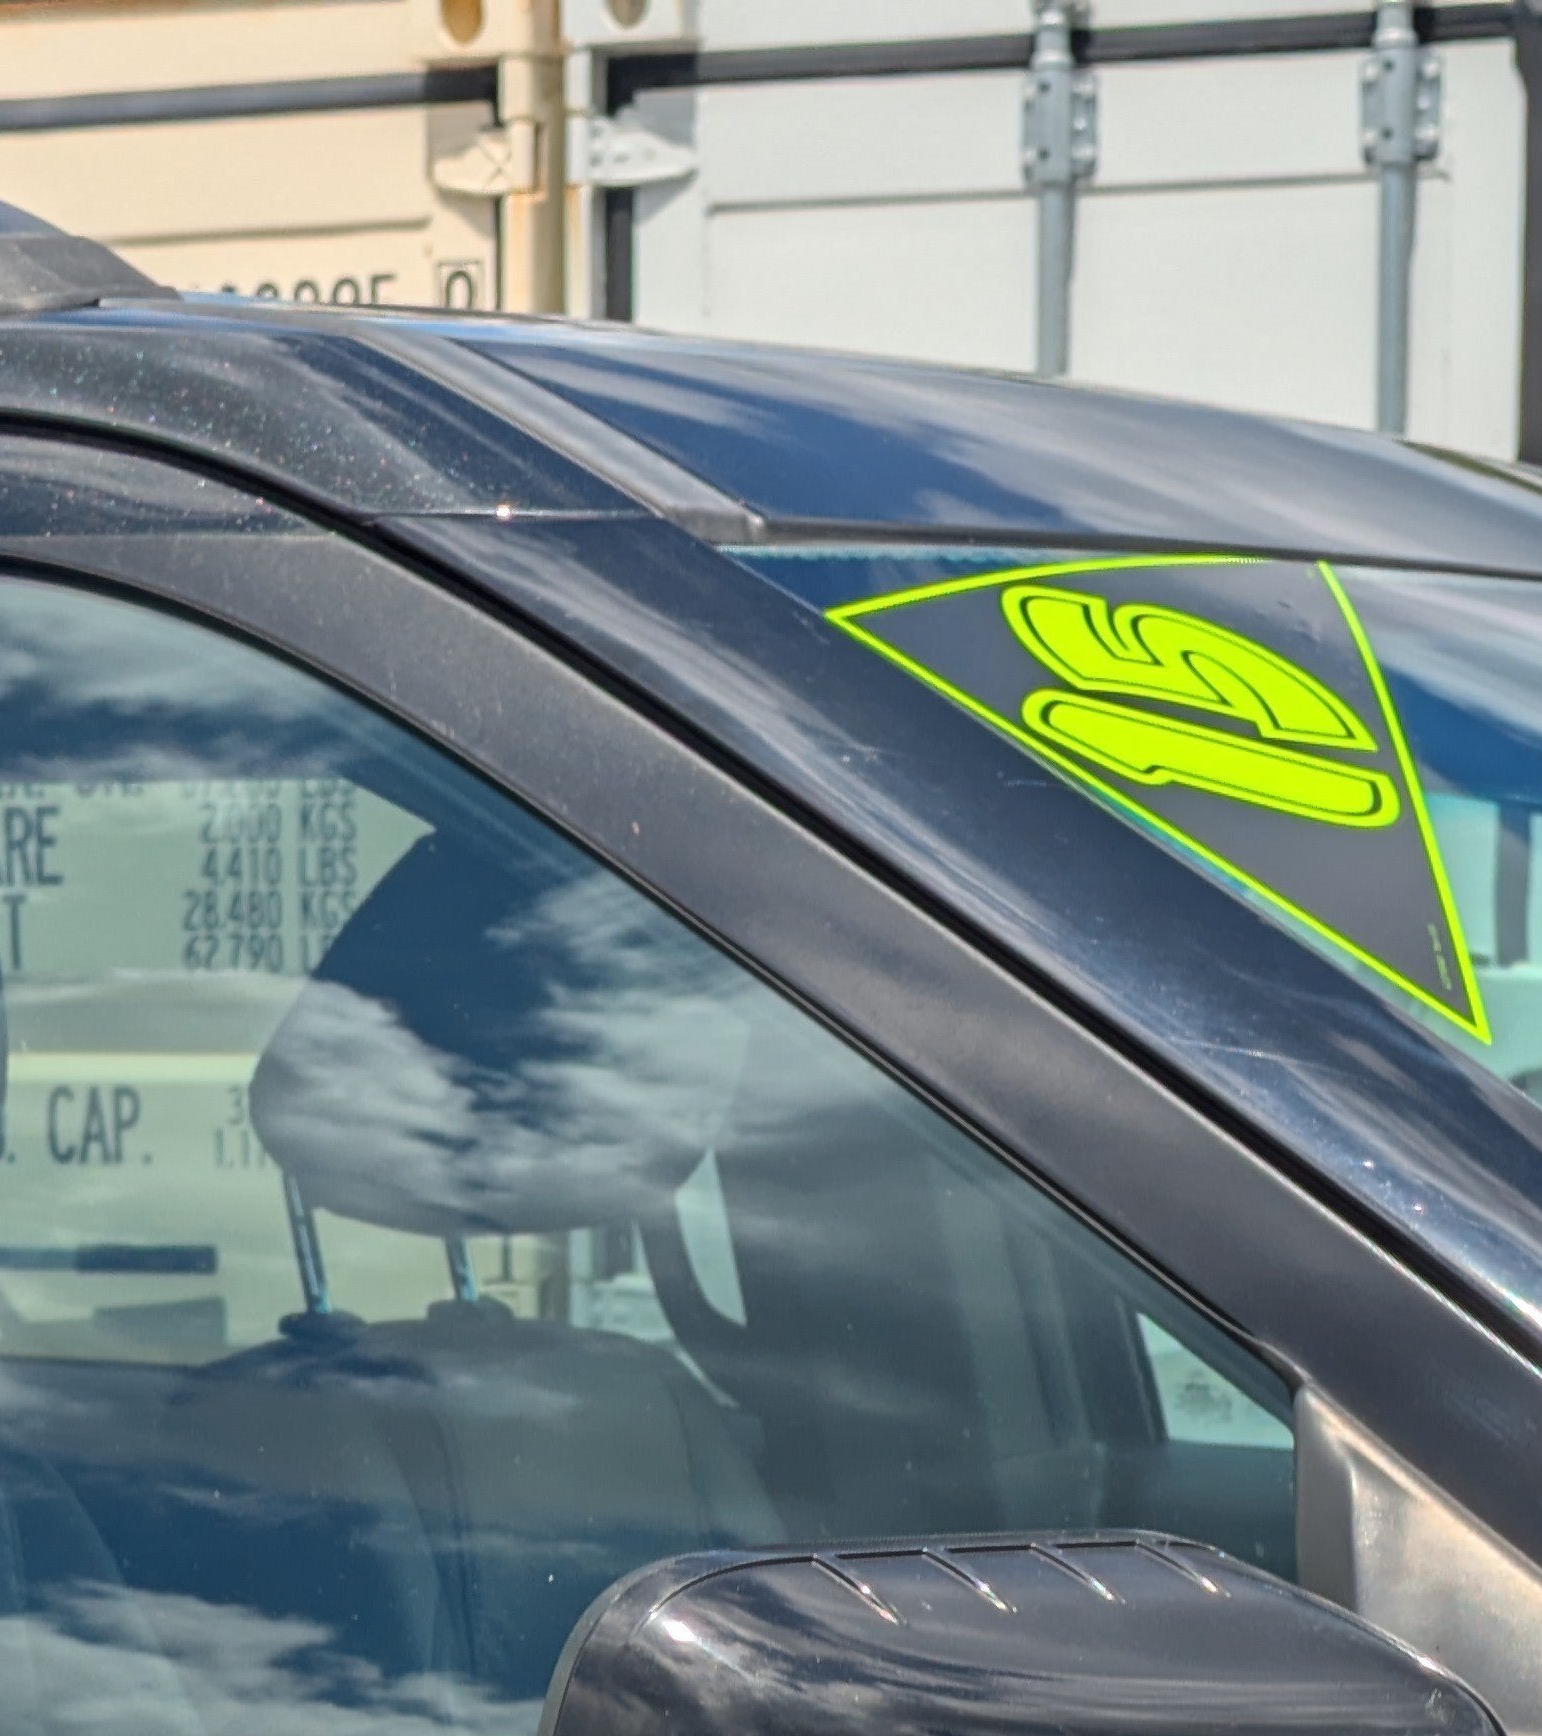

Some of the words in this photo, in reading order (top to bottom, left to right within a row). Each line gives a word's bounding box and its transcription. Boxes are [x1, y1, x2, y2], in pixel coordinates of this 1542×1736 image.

[299, 802, 357, 843] KGS
[299, 846, 357, 887] LBS
[47, 1085, 152, 1165] CAP.
